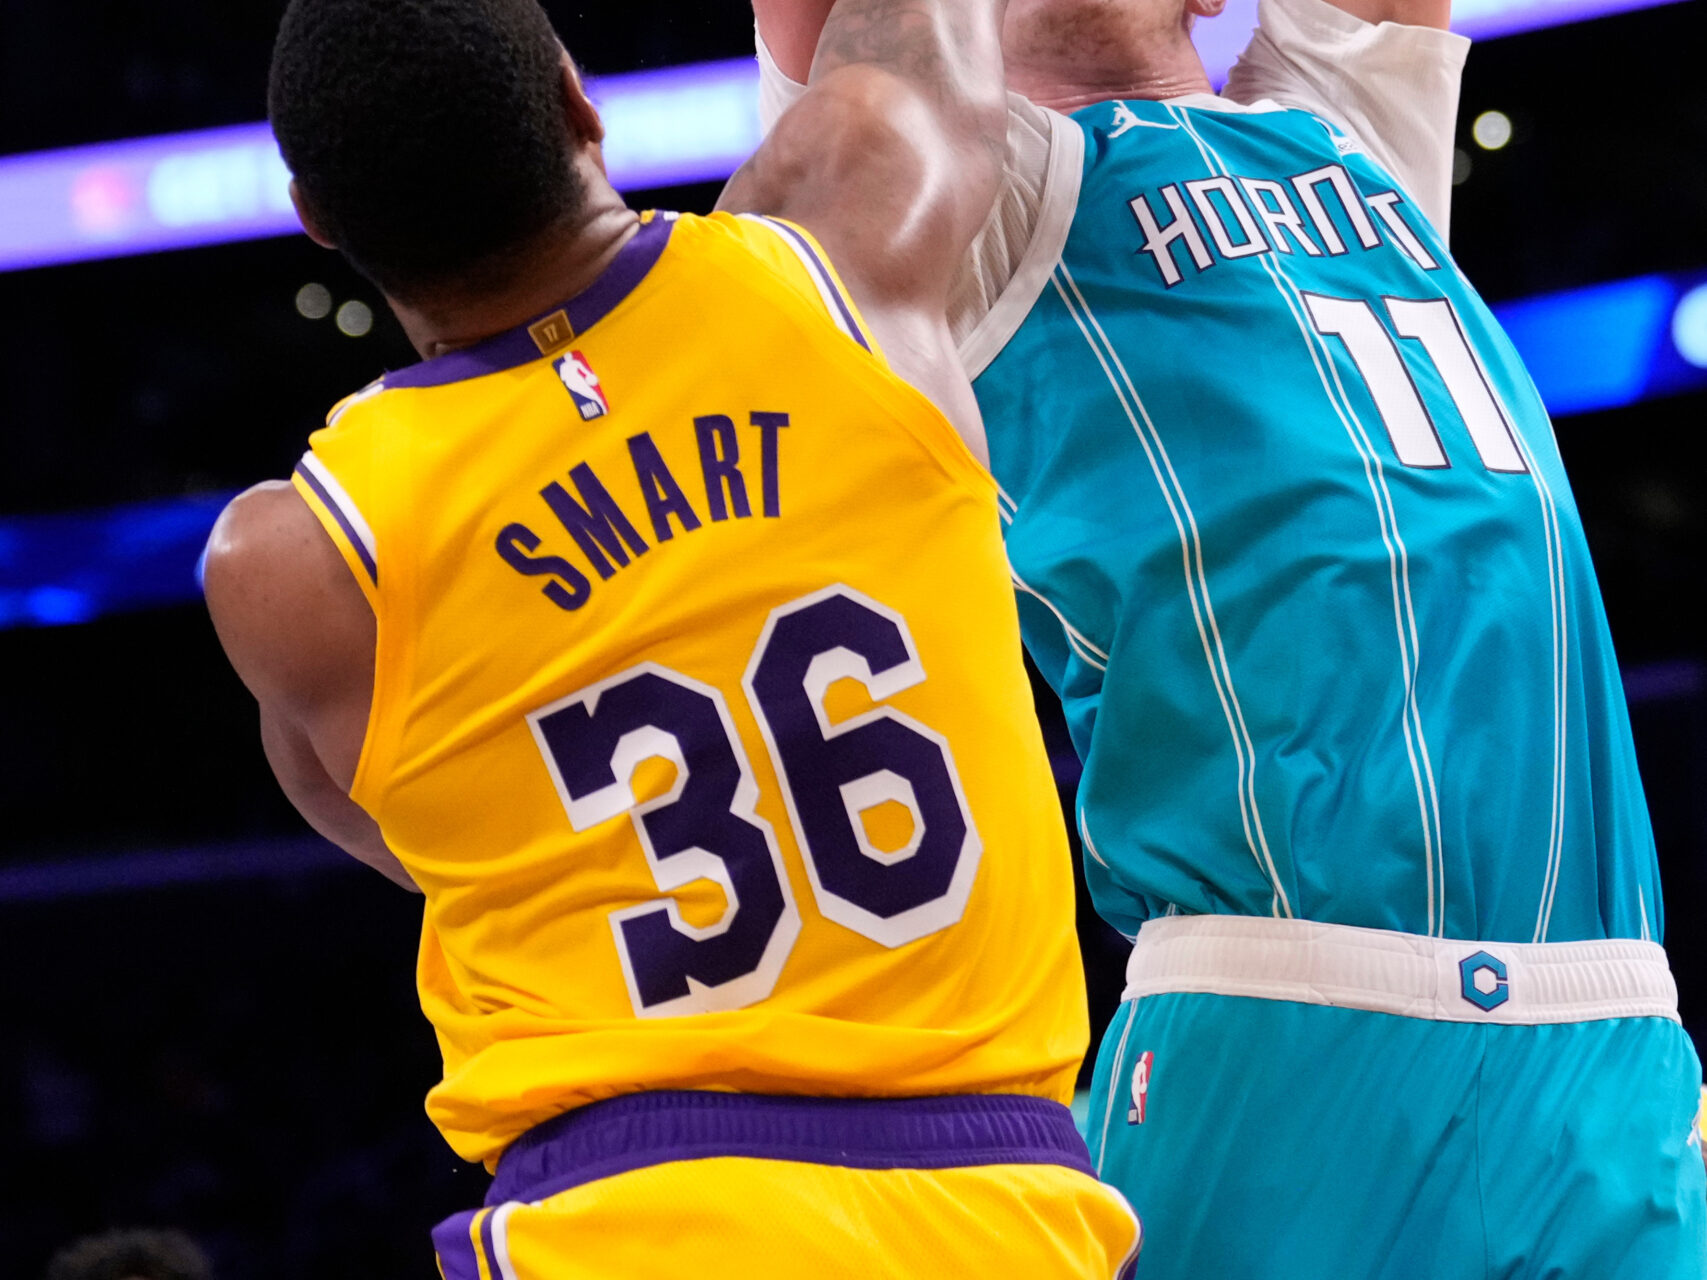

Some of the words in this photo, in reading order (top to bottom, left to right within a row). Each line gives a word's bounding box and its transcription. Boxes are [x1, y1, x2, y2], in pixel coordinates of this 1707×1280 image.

[1300, 290, 1531, 475] 11
[495, 410, 790, 612] SMART
[525, 581, 984, 1021] 36
